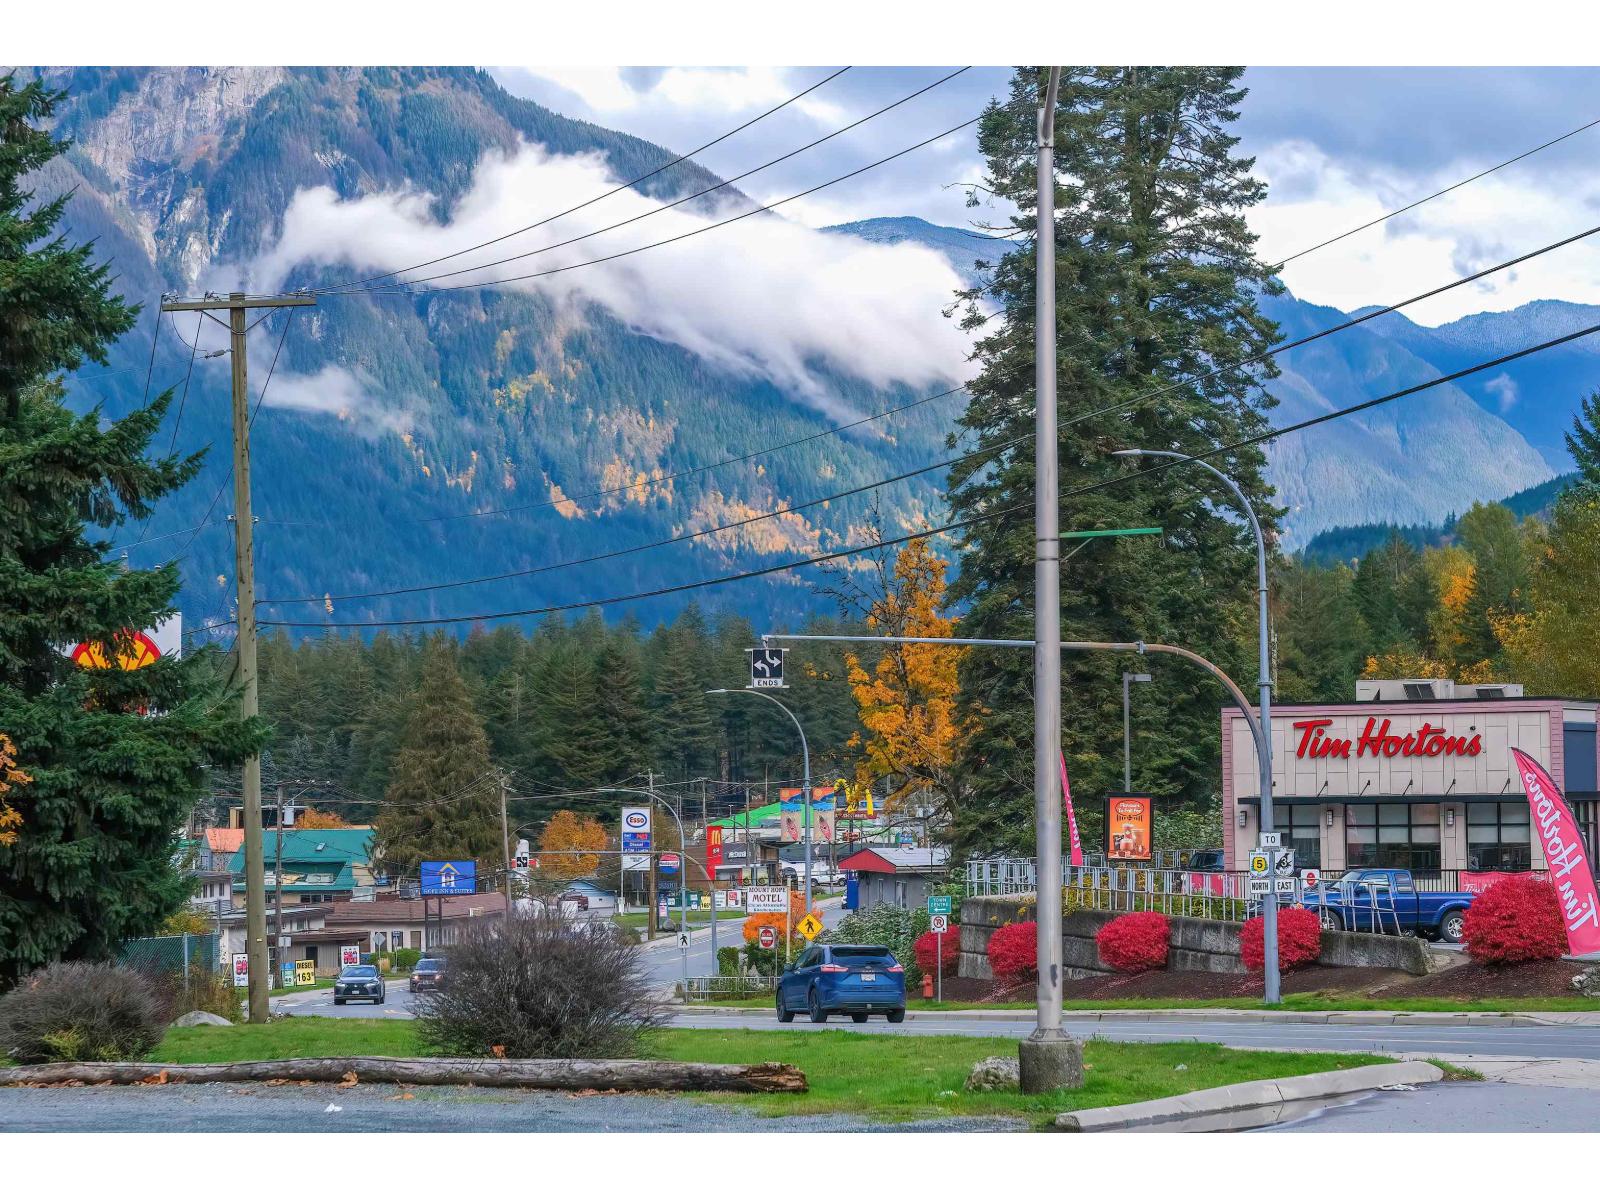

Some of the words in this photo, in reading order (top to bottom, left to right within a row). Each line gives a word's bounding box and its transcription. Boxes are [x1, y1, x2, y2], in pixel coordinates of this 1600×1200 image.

[1293, 719, 1352, 759] Tim
[1357, 717, 1482, 758] Hortons
[629, 816, 645, 824] Esso
[1256, 860, 1263, 868] 5
[1281, 857, 1287, 867] 3
[1251, 882, 1269, 891] NORTH
[1277, 882, 1292, 890] EAST
[752, 894, 783, 902] MOTEL
